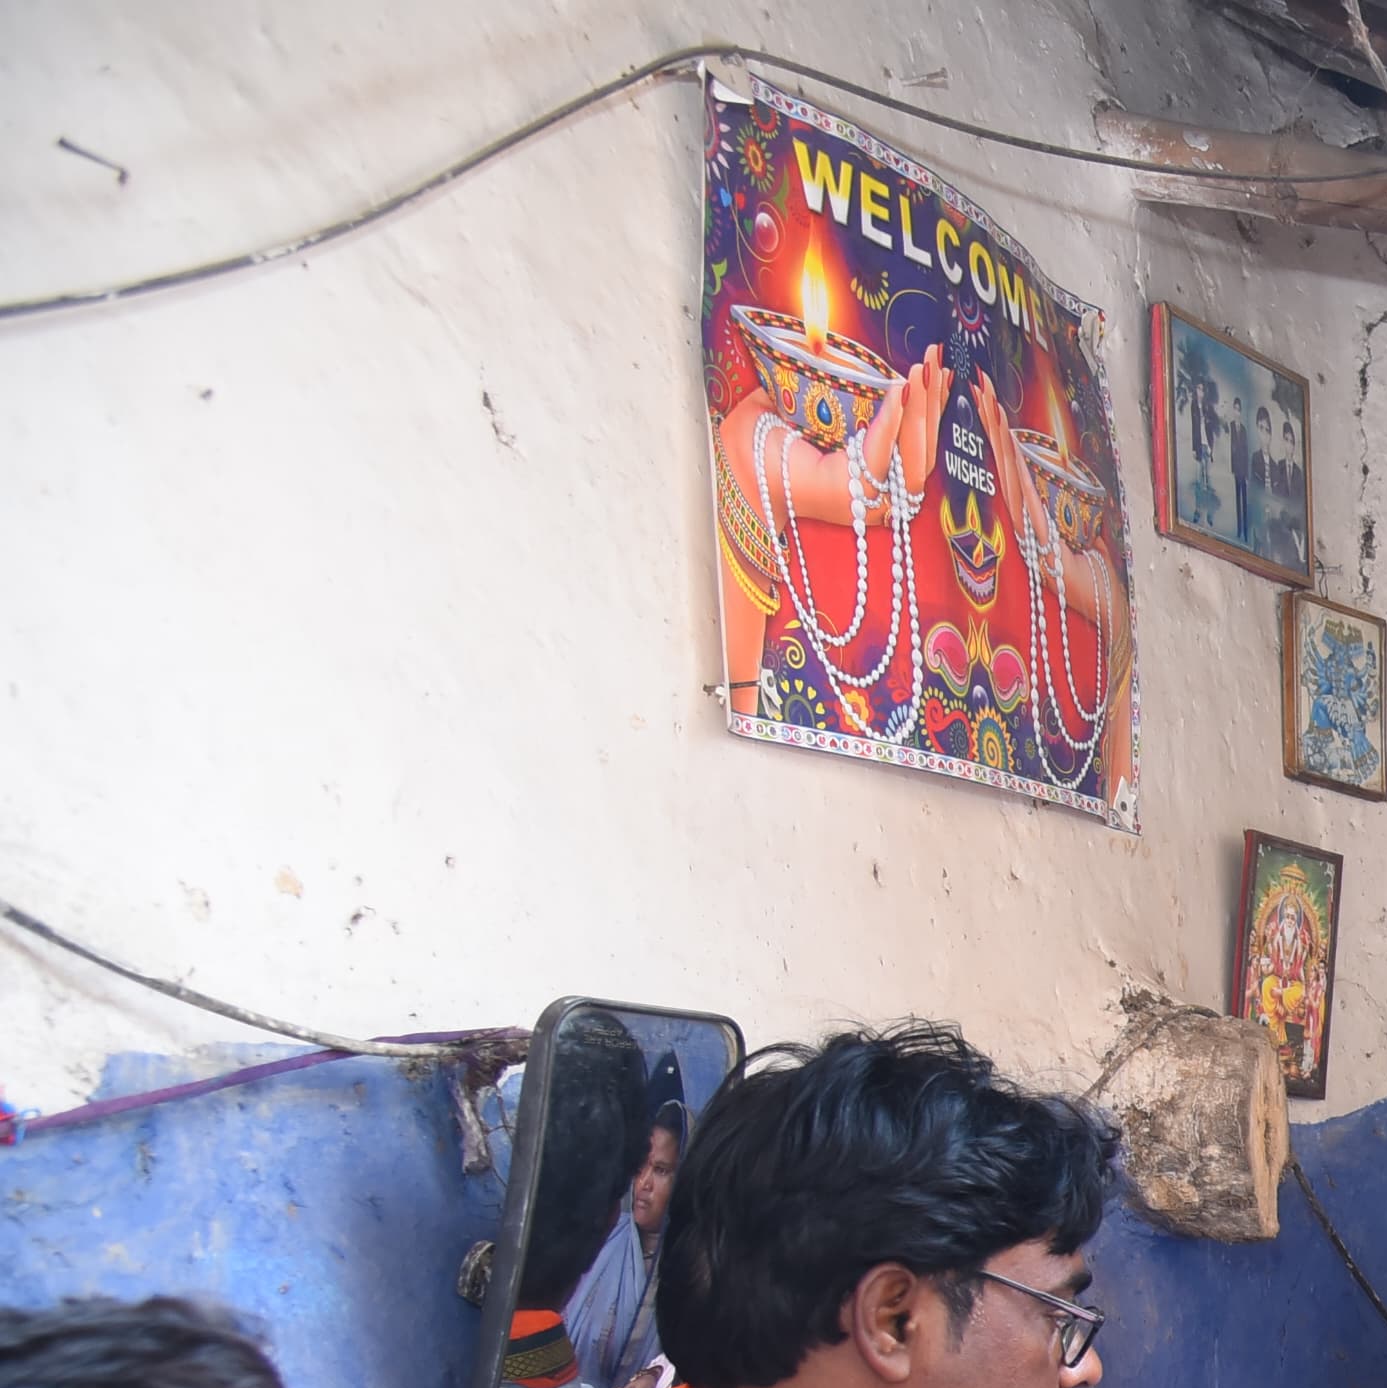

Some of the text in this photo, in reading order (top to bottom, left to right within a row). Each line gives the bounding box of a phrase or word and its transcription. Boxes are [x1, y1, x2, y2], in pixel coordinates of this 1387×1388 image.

[792, 136, 1049, 352] WELCOME
[952, 422, 984, 460] BEST
[945, 450, 996, 497] WISHES
